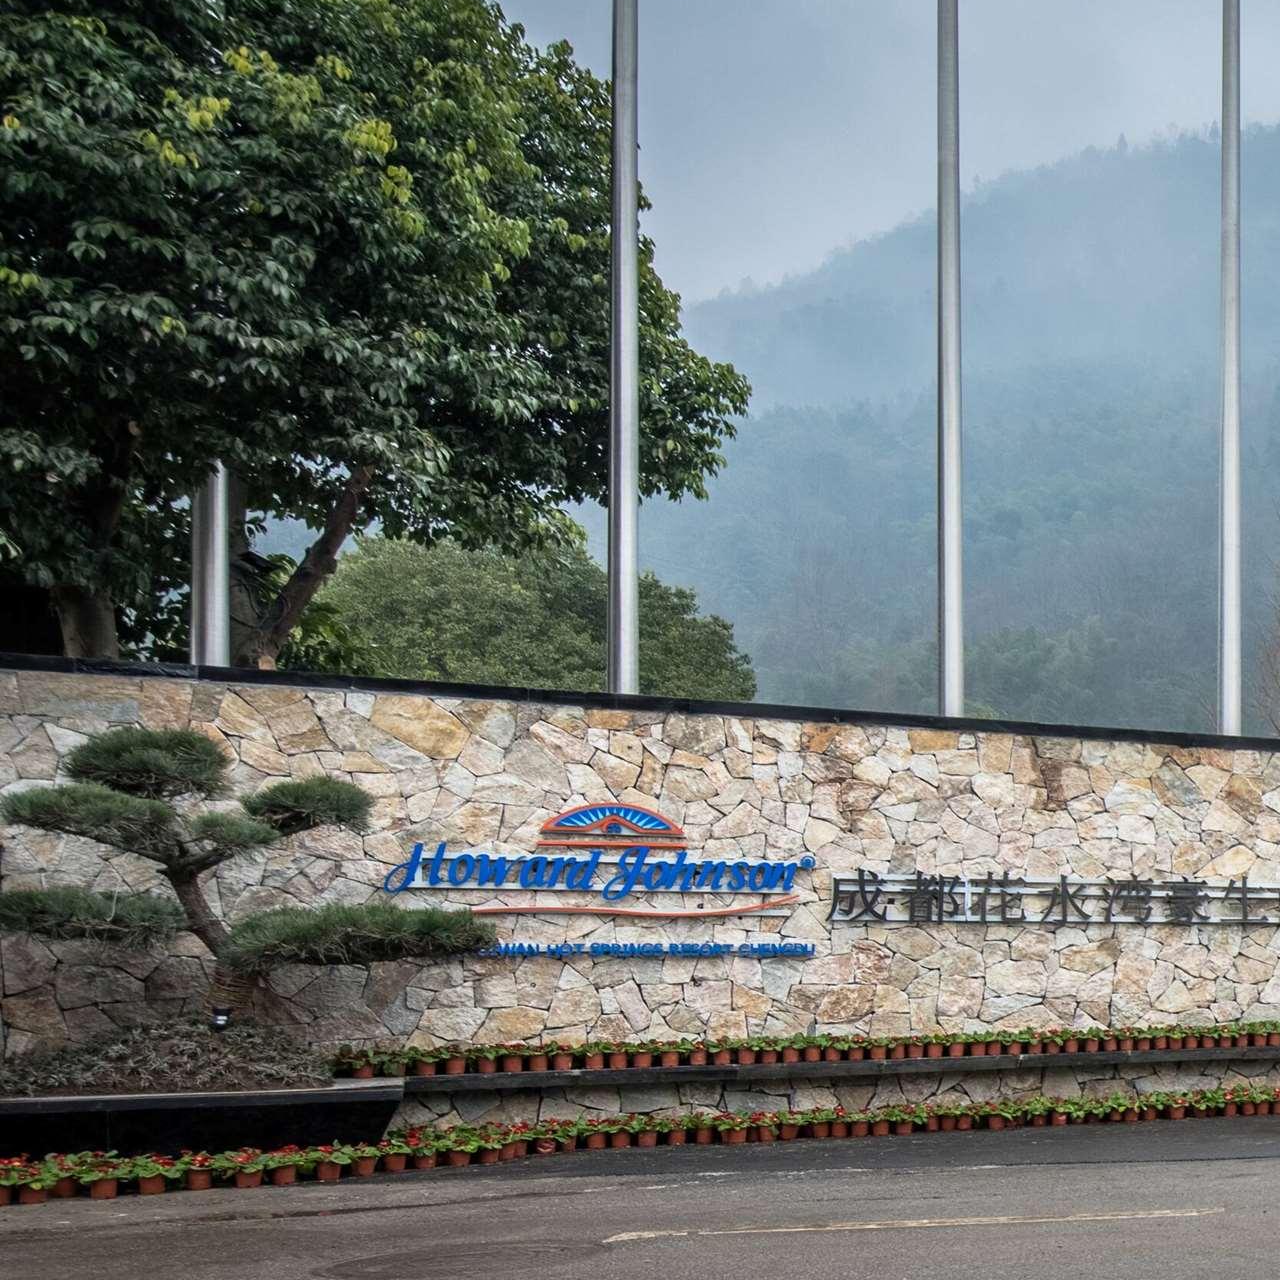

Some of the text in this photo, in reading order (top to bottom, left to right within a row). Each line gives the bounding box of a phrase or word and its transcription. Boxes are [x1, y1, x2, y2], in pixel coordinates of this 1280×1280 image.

[384, 841, 797, 901] Howard Johnson
[547, 943, 584, 957] HOT
[589, 943, 663, 958] SPRINGS
[668, 943, 734, 957] RESORT
[738, 943, 816, 958] CHENGDU
